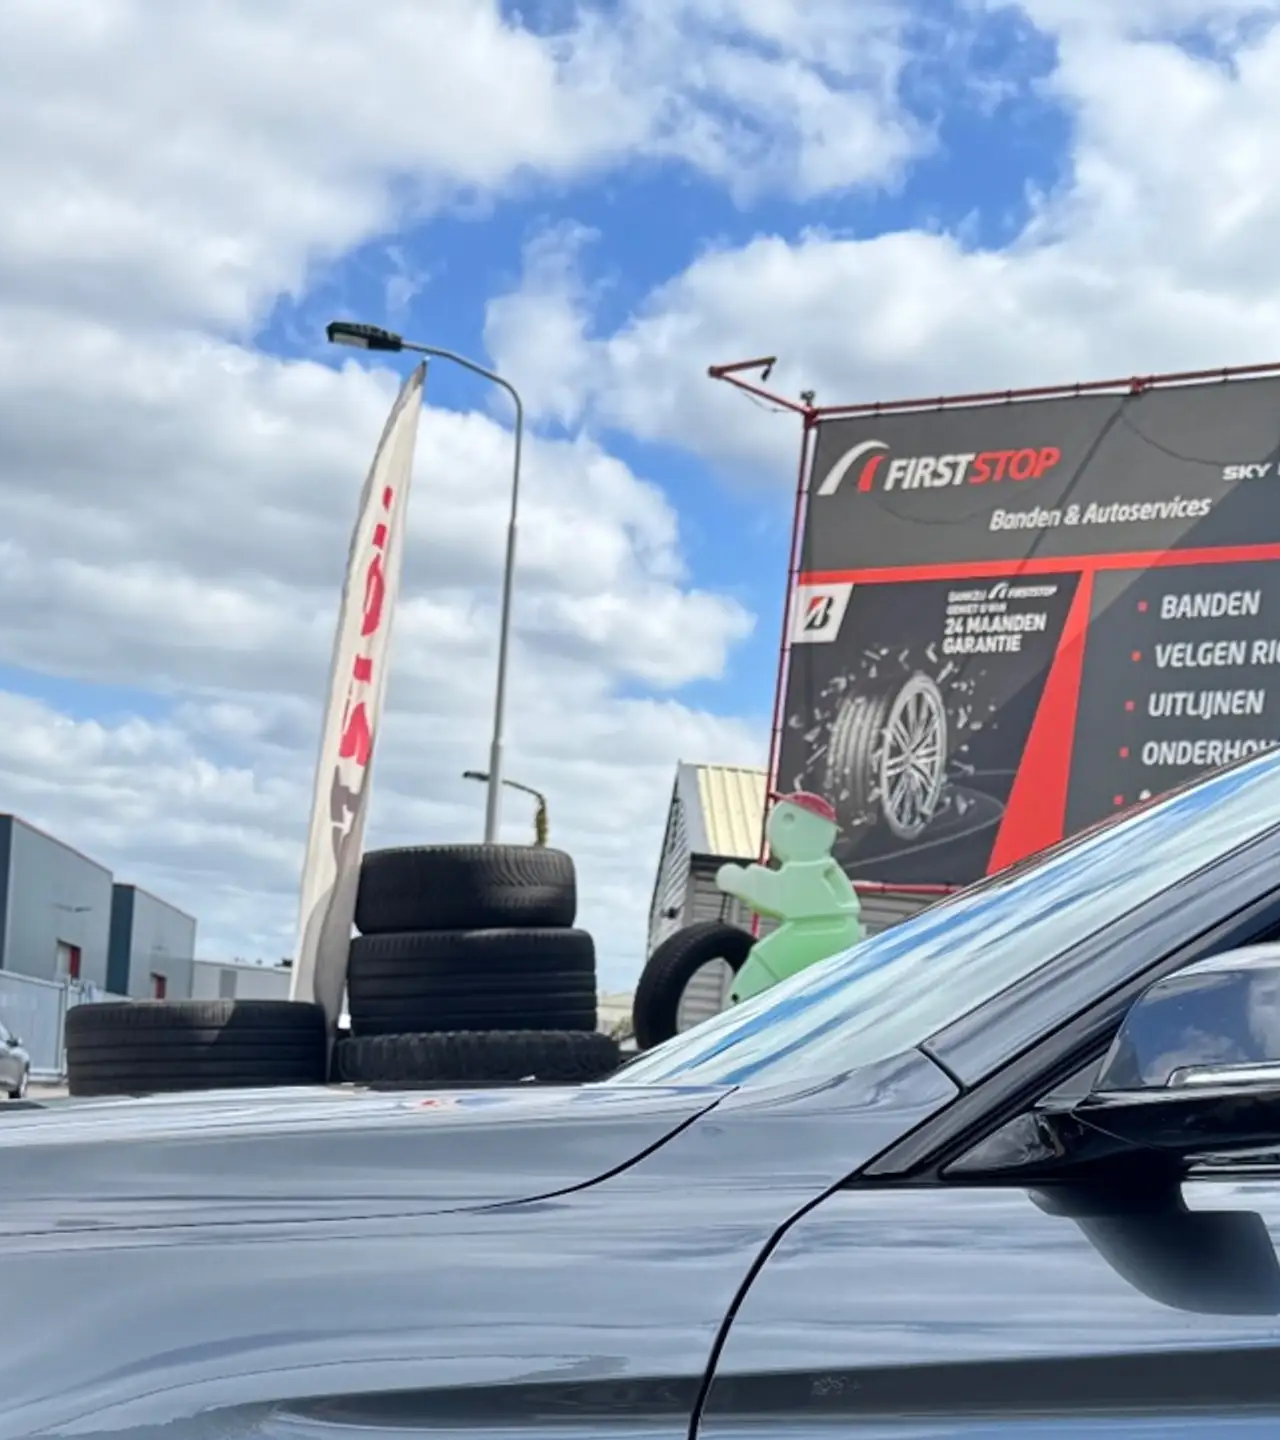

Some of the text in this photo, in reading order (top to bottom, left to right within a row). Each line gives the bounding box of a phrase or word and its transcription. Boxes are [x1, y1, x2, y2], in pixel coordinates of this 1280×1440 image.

[884, 447, 1061, 491] FIRSTSTOP
[1223, 462, 1272, 481] SKY
[990, 496, 1212, 531] Banden & Autoservices
[1160, 590, 1262, 620] BANDEN
[944, 612, 1047, 634] 24 MAANDEN
[942, 633, 1022, 655] GARANTIE
[1155, 641, 1248, 668] VELGEN
[1148, 689, 1265, 720] UITLIJNEN
